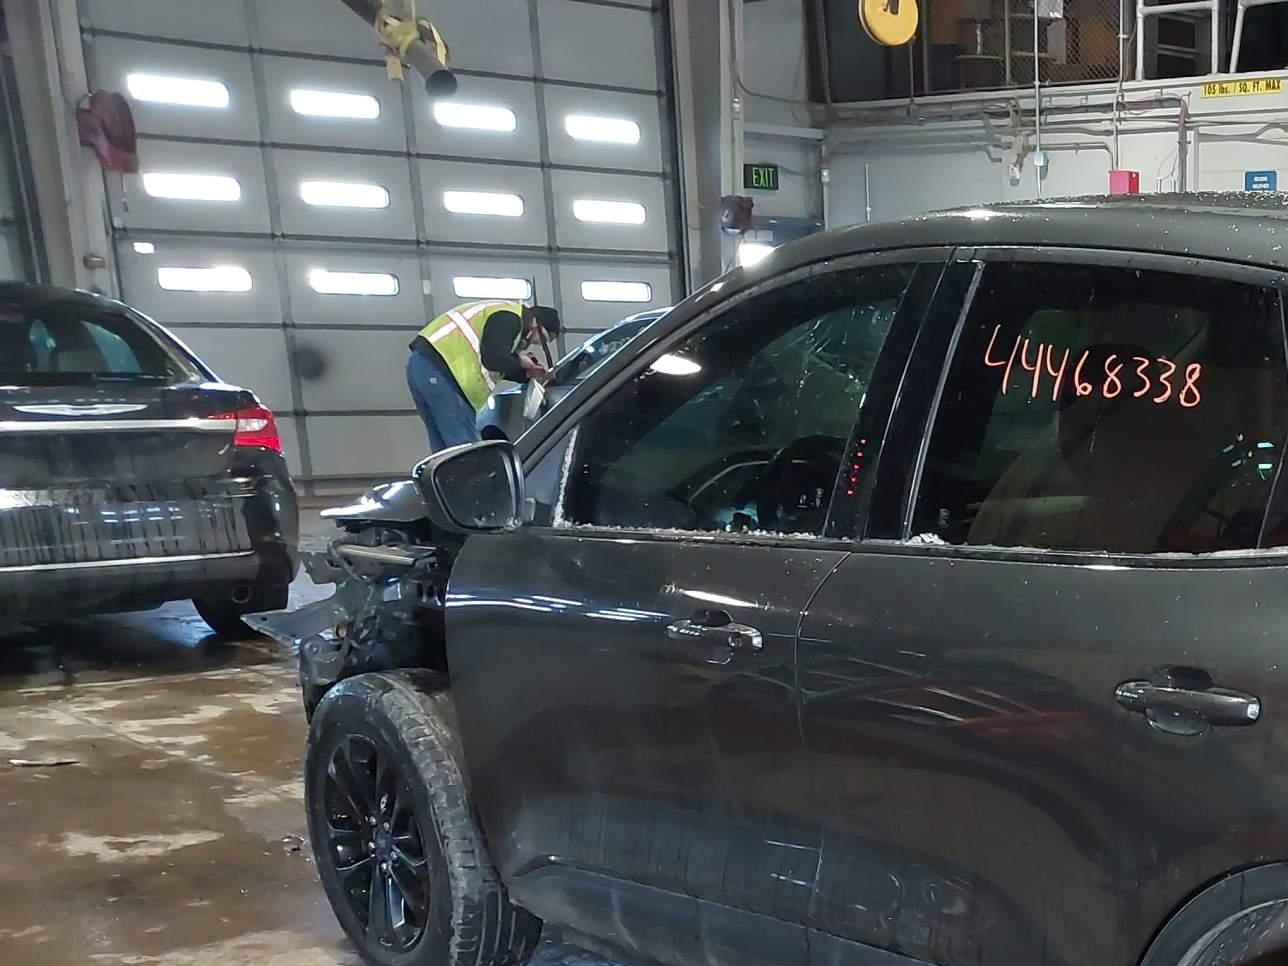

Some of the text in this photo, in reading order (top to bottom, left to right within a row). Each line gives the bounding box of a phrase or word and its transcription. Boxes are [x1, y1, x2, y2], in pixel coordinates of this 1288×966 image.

[1204, 83, 1216, 96] 105
[1239, 82, 1250, 93] SQ.
[1252, 81, 1262, 92] FT.
[1265, 80, 1281, 91] MAX
[752, 167, 774, 187] EXIT
[984, 323, 1202, 408] 44468338
